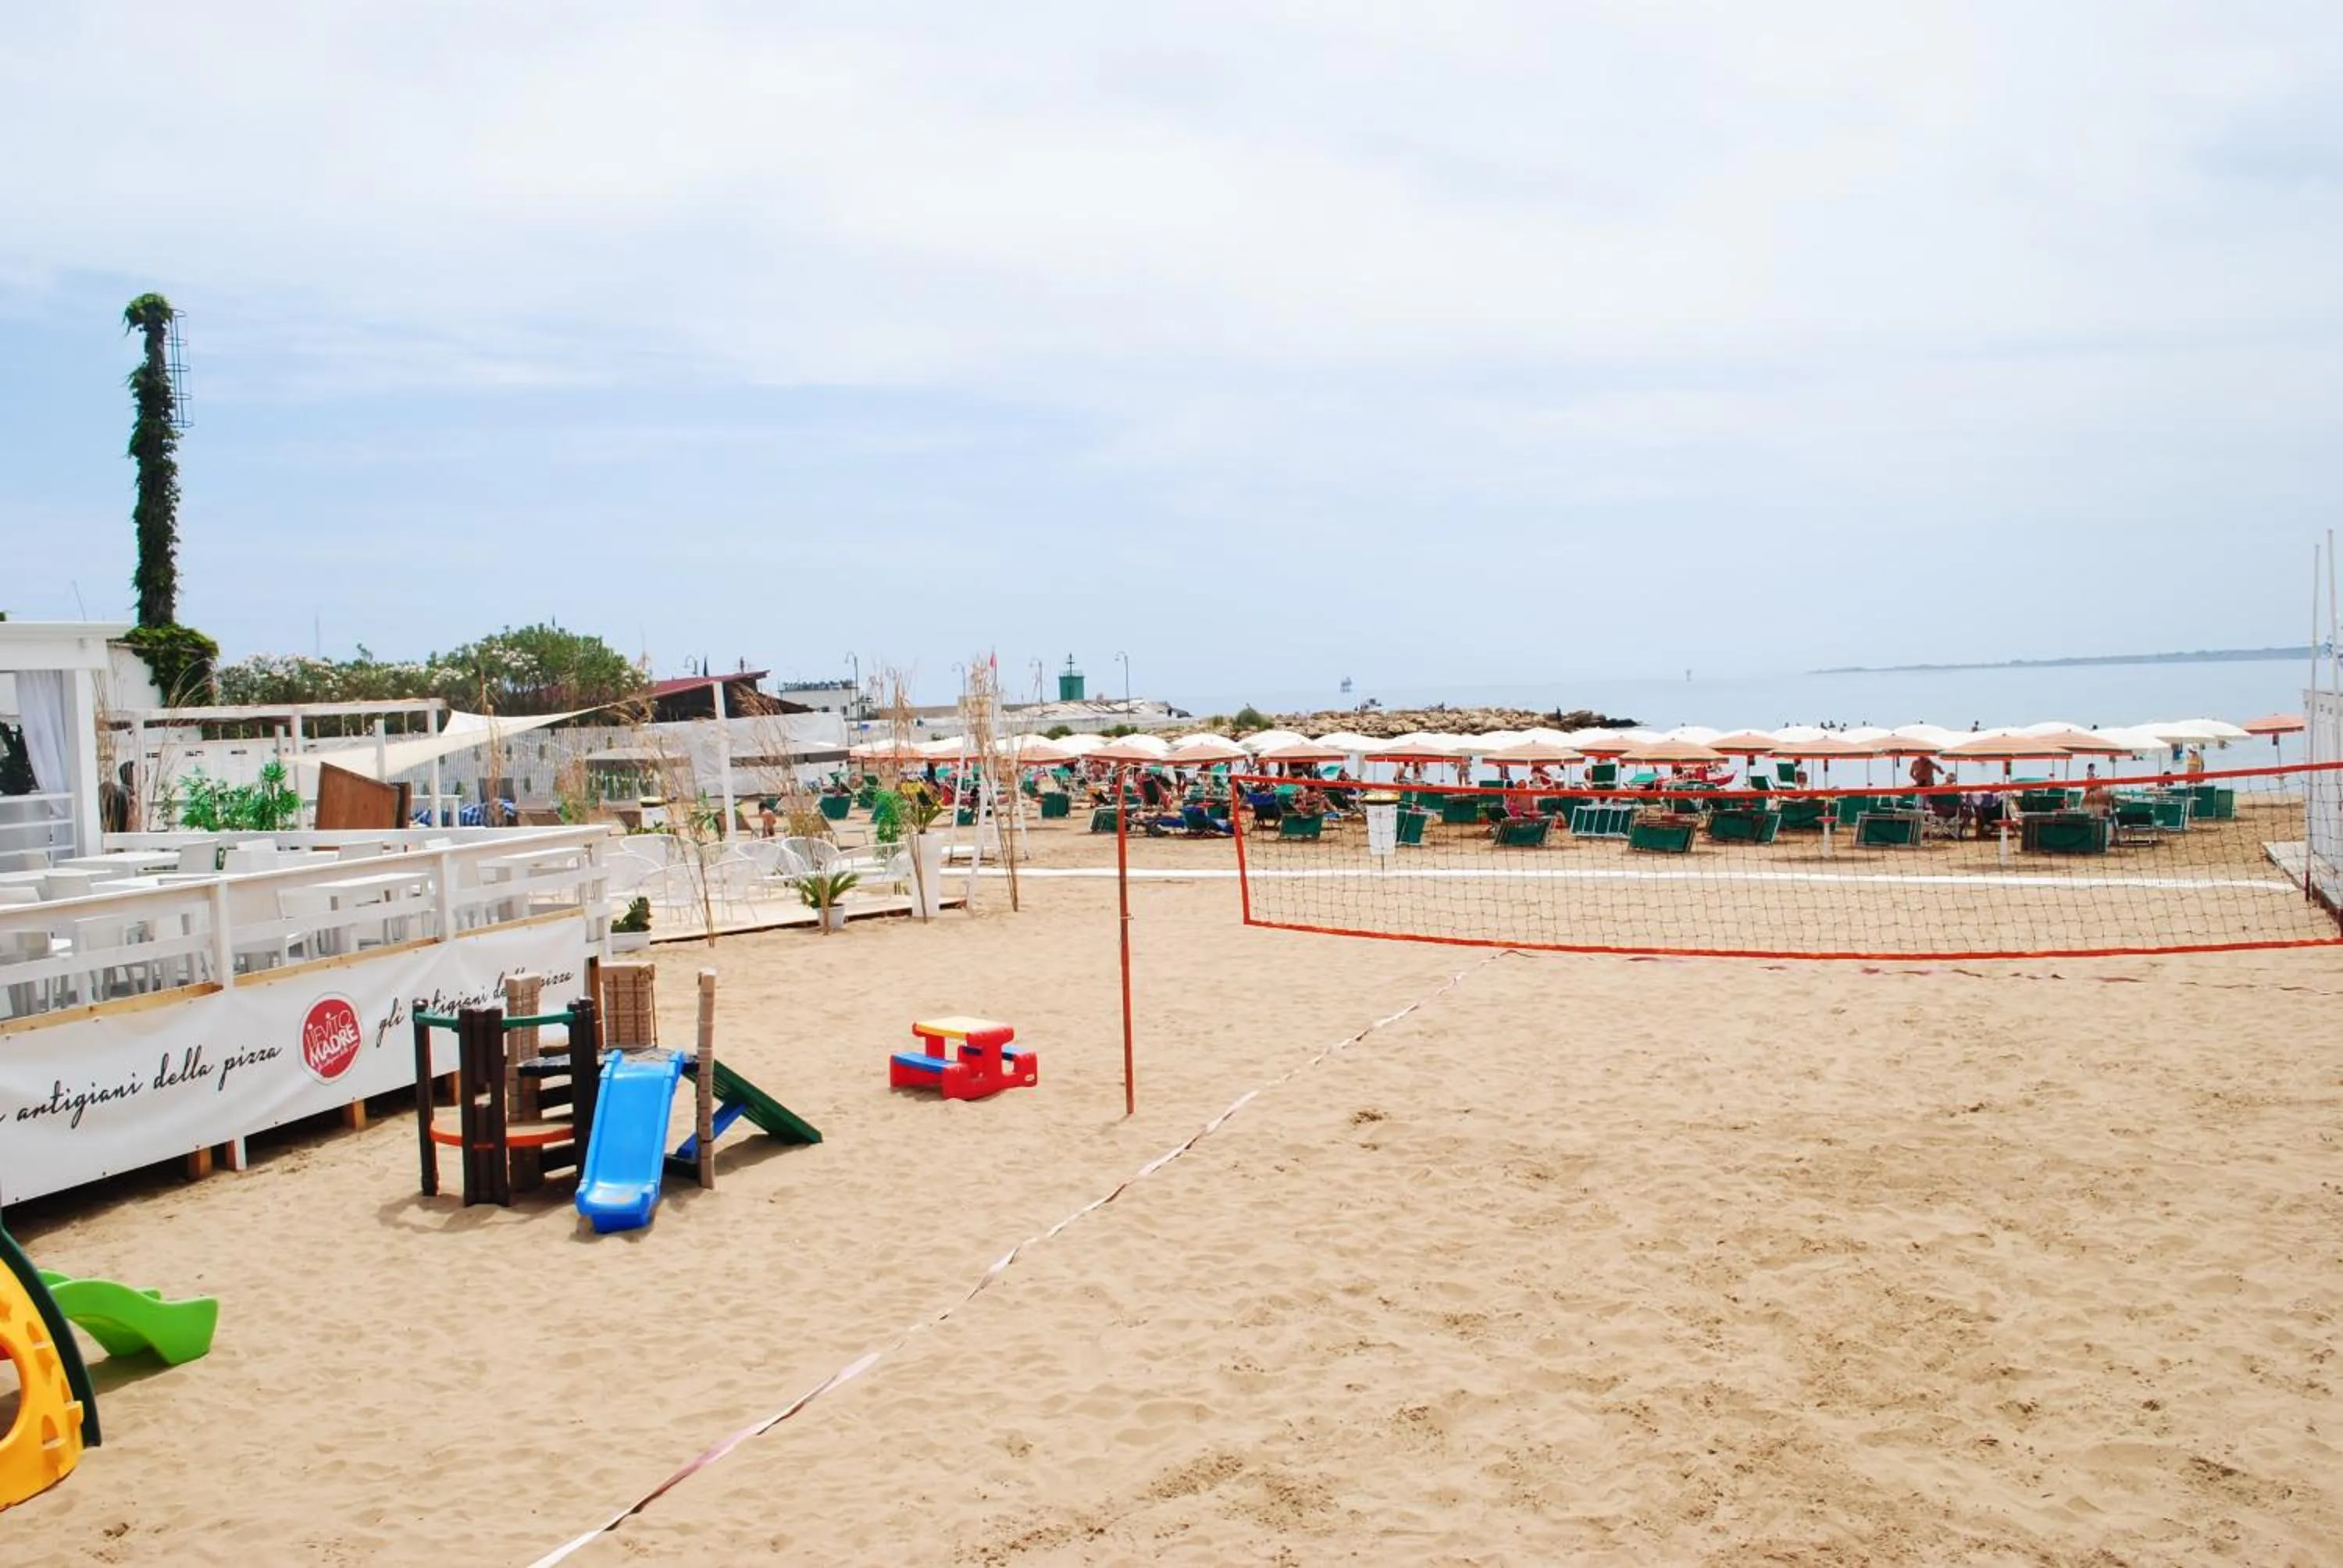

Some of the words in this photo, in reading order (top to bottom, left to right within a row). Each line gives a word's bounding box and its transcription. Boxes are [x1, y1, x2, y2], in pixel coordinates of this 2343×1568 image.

[376, 996, 405, 1048] gli
[431, 985, 490, 1016] tigiani
[153, 1044, 215, 1089] della
[218, 1044, 283, 1092] pizza
[309, 1025, 358, 1067] MADRE
